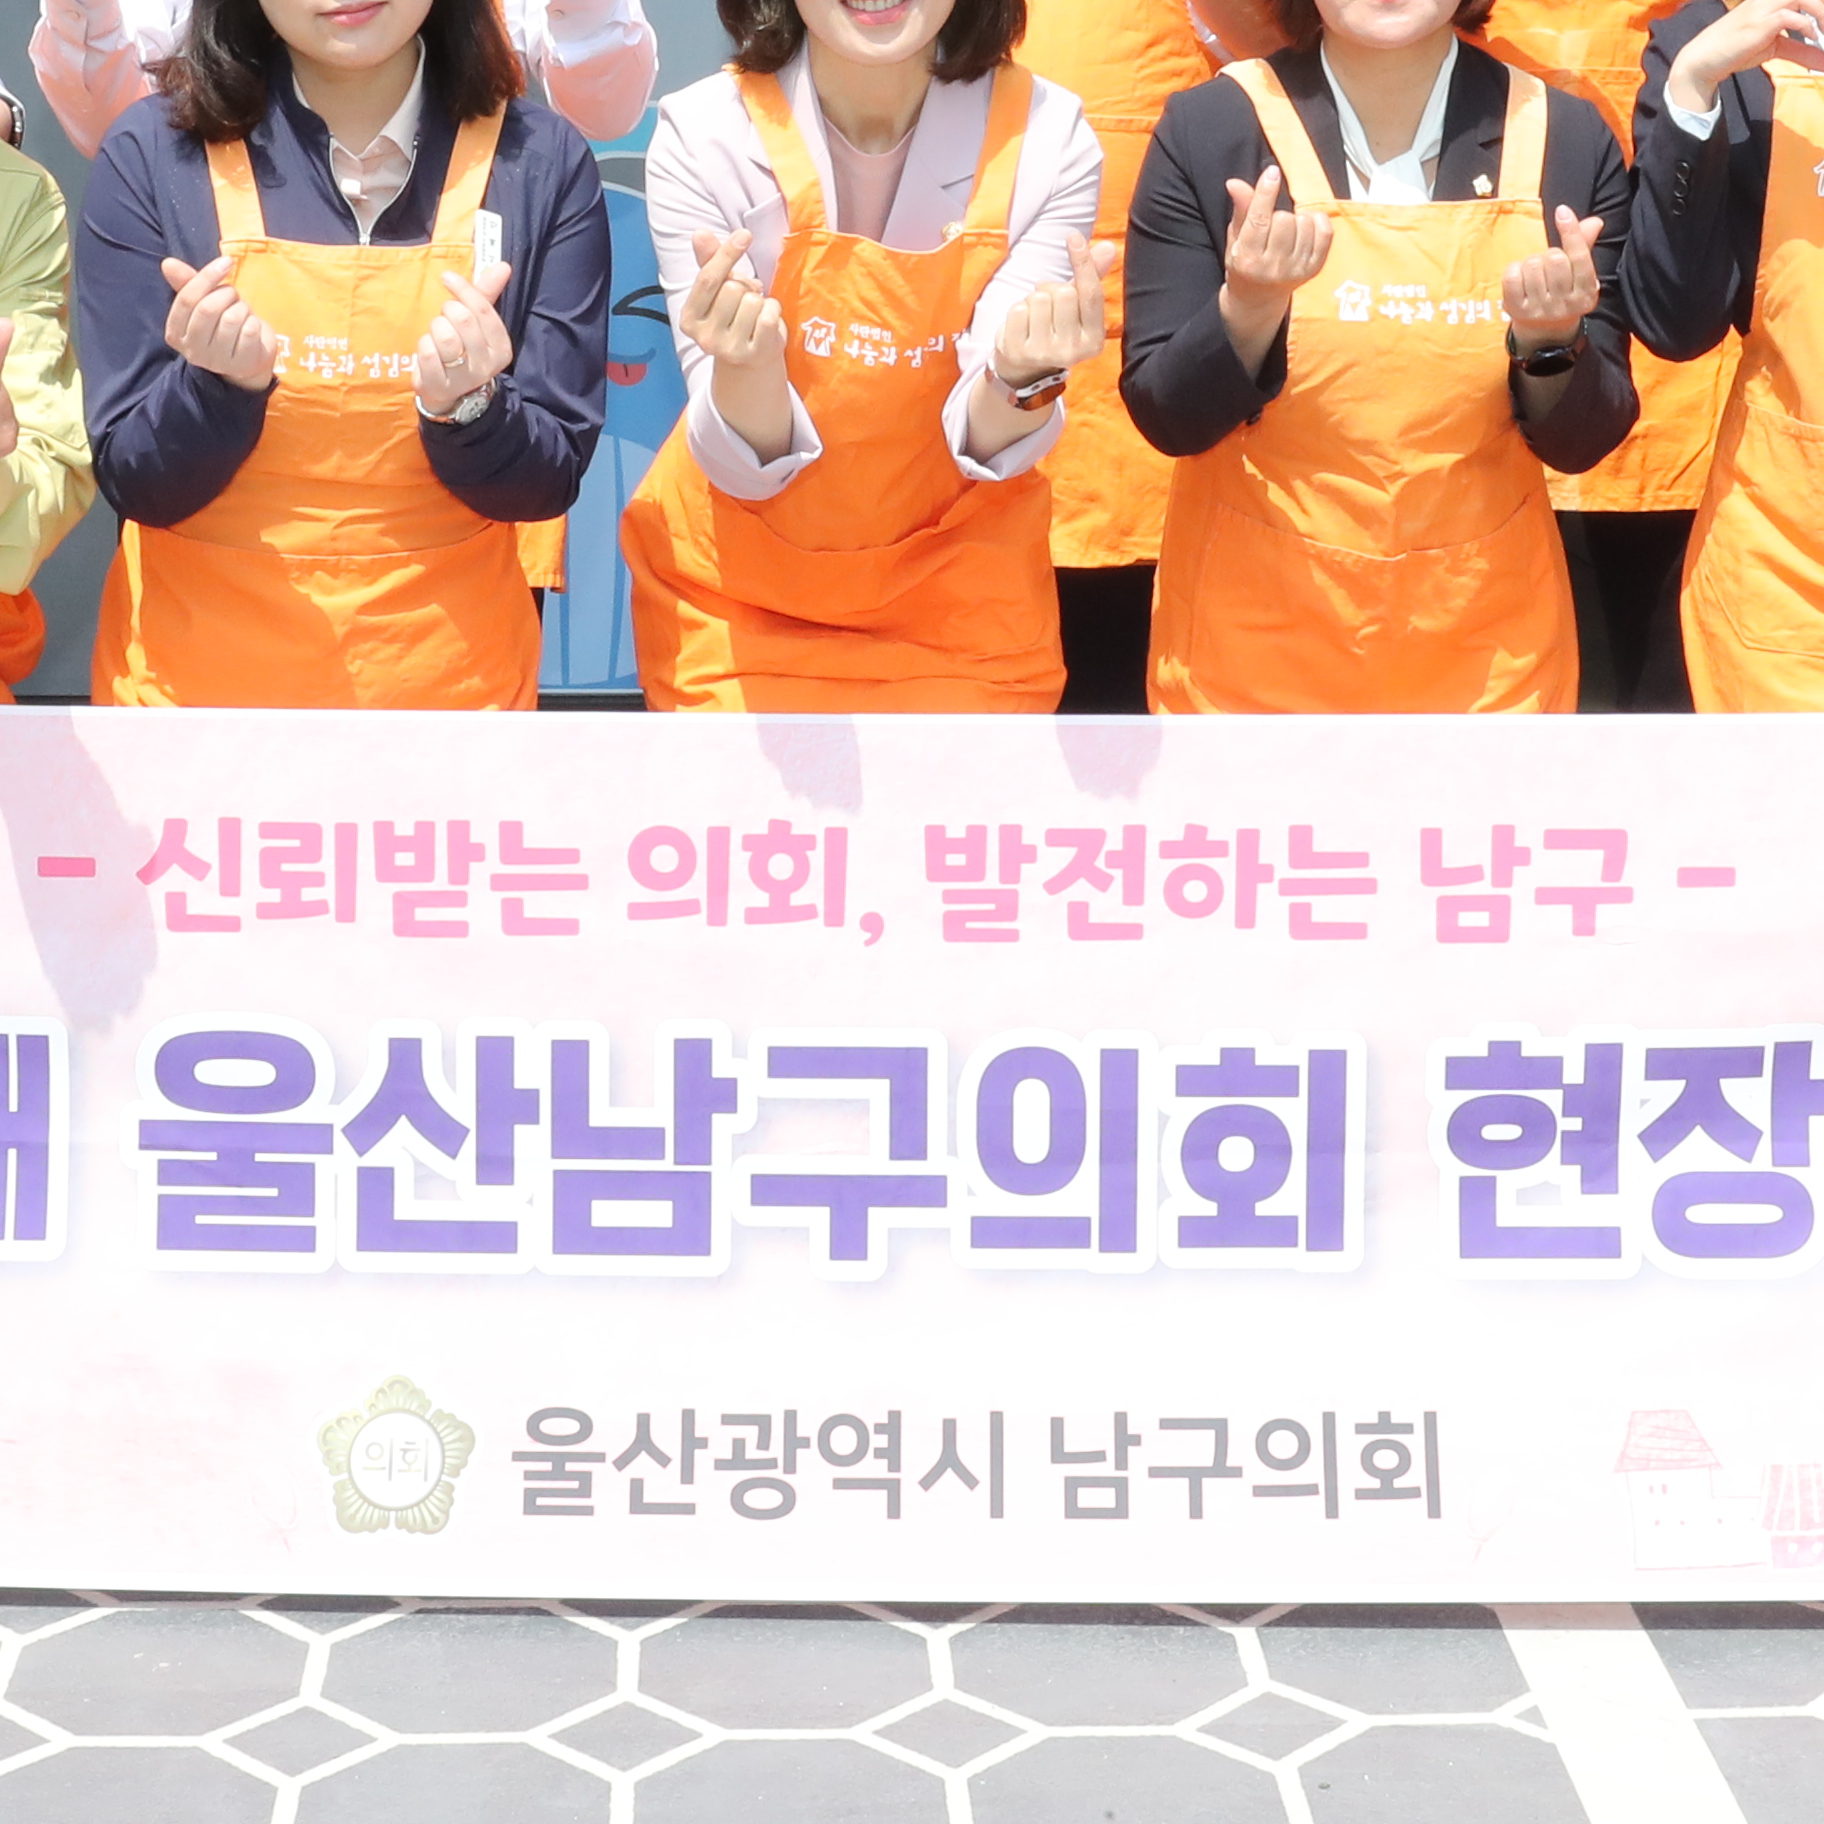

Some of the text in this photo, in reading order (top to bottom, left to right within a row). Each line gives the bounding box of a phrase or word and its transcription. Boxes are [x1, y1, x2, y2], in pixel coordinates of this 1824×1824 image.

[298, 353, 355, 379] 나눔과
[843, 340, 897, 367] 나눔과
[136, 817, 589, 939] 신뢰받는
[627, 818, 886, 947] 의회,
[924, 823, 1378, 943] 발전하는
[1420, 824, 1634, 944] 남구
[139, 1030, 1347, 1261] 울산남구의회
[511, 1406, 1442, 1521] 울산광역시 남구의회
